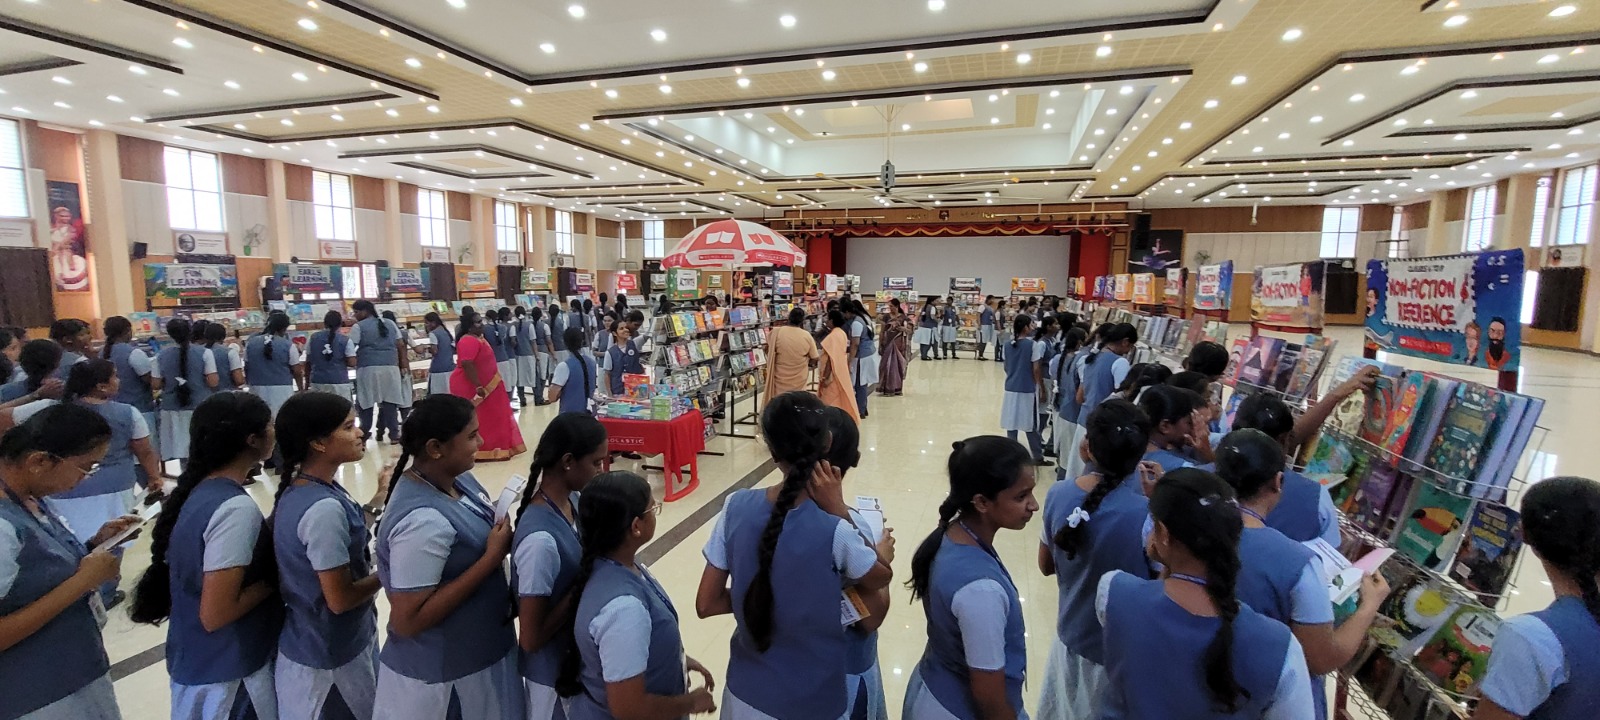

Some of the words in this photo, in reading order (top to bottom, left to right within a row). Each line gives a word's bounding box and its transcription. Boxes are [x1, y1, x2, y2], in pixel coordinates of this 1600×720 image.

[184, 269, 203, 278] FUN
[170, 278, 219, 290] LEARNING
[1388, 276, 1457, 300] NON-FICTION
